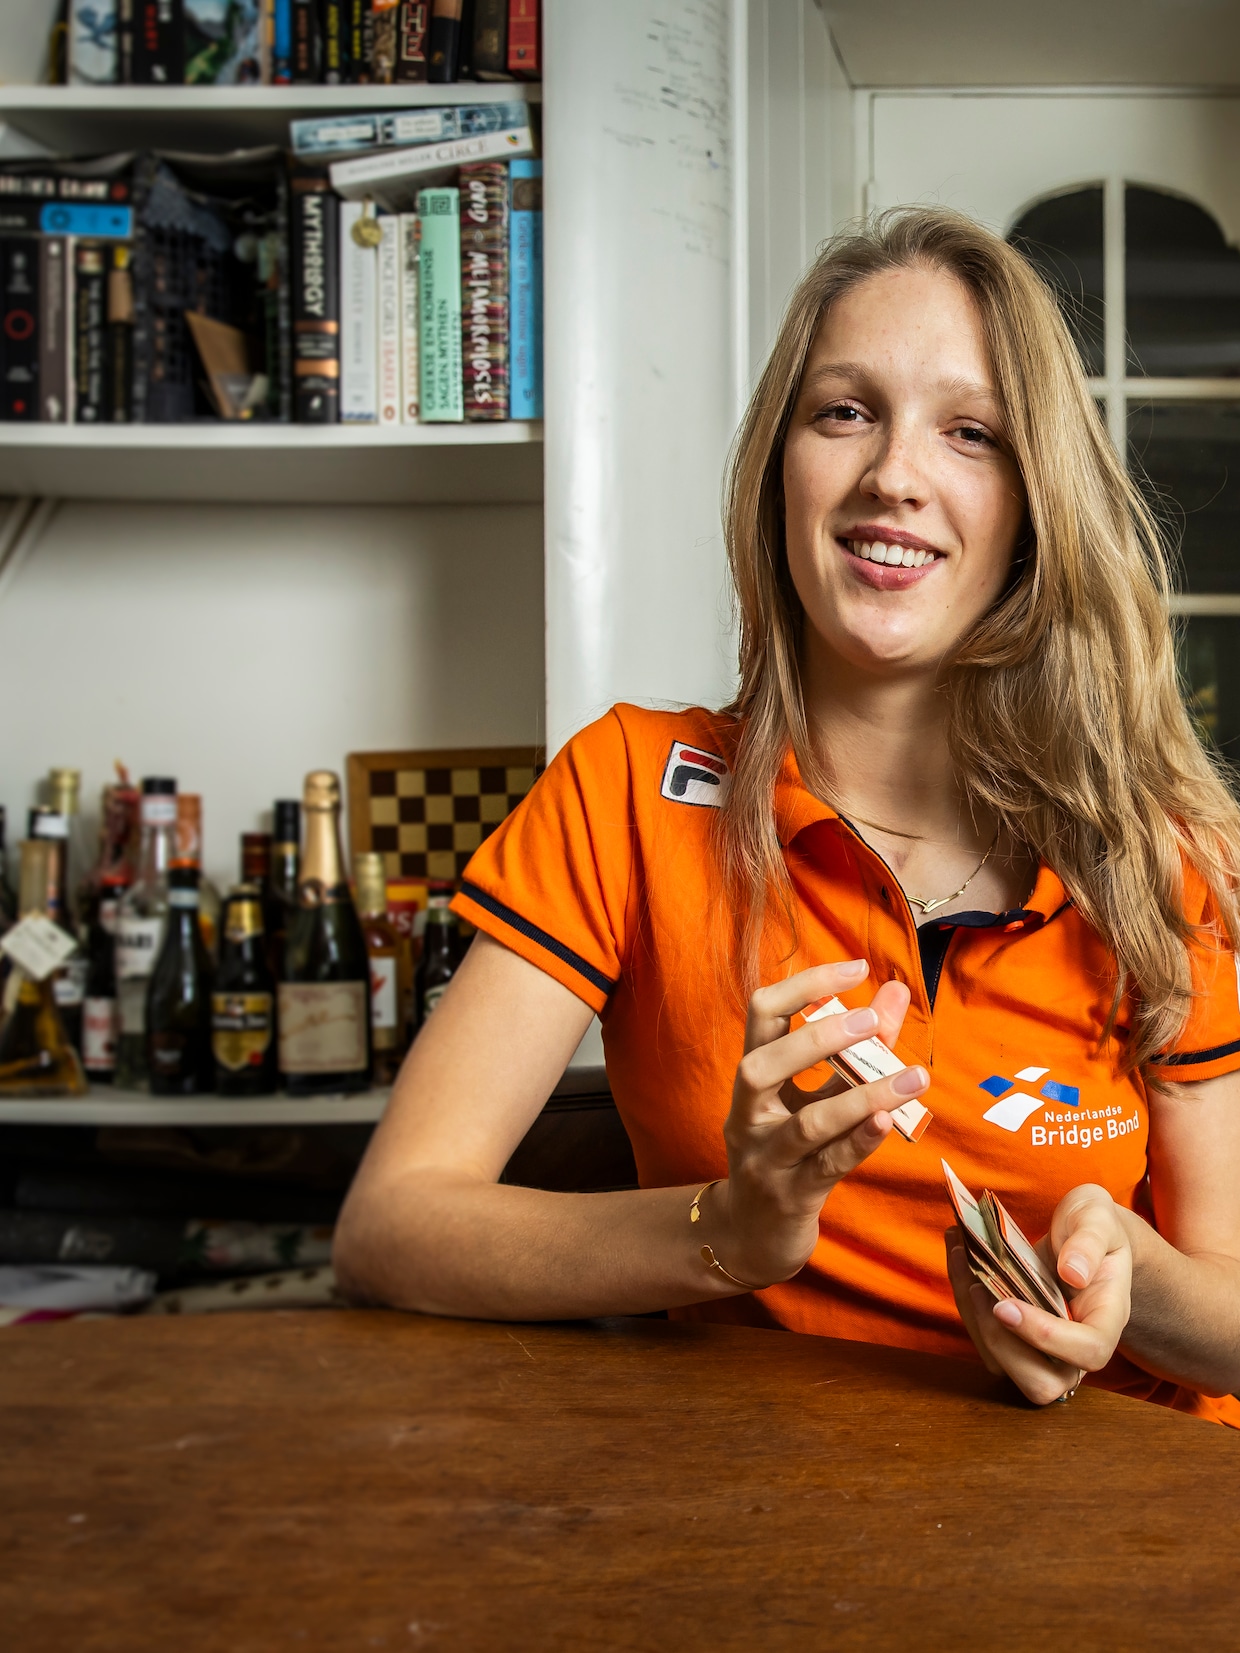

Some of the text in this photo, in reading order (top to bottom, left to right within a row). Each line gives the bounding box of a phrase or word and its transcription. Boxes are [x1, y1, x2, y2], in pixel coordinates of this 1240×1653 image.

[435, 139, 488, 162] CIRCE
[301, 195, 326, 316] MYTHOLOGY
[467, 181, 493, 404] OVID METAMORPHOSES
[383, 299, 397, 336] GIRLS
[423, 248, 435, 411] GRIEKSE EN ROMEINSE
[438, 299, 449, 411] SAGEN MYTHEN
[515, 345, 528, 378] sagen
[1031, 1110, 1140, 1149] Bridge Bond
[1044, 1105, 1123, 1123] Nederlandse
